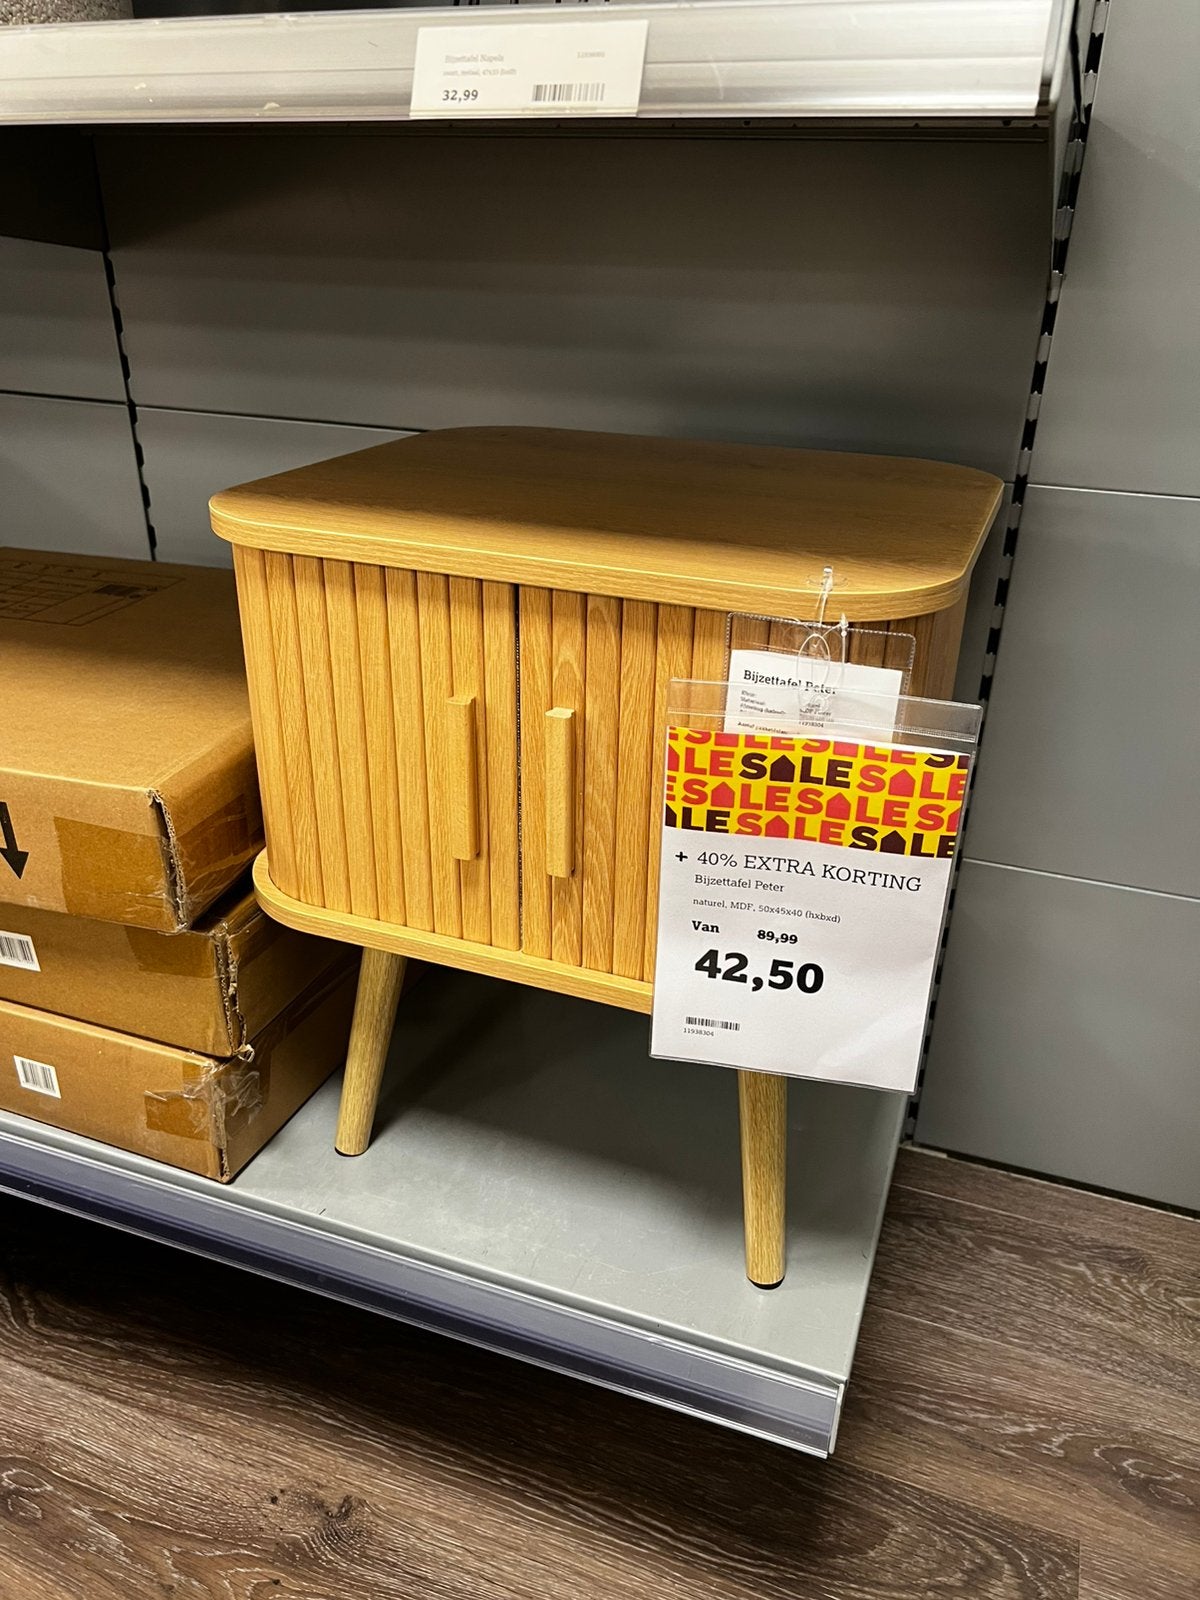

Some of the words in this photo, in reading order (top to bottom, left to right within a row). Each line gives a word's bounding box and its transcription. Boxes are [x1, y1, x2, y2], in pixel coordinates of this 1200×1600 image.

[442, 90, 479, 103] 32,99
[743, 669, 802, 687] Bijzettafel
[738, 752, 853, 789] SALE
[697, 851, 738, 868] 40%
[744, 855, 815, 876] EXTRA
[821, 864, 921, 891] KORTING
[694, 874, 751, 889] Bijzettafel
[755, 880, 785, 892] Peter
[758, 904, 803, 917] 50x45x40
[805, 910, 841, 923] (hxbxd)
[692, 920, 720, 933] Van
[757, 929, 798, 944] 89,99
[694, 949, 824, 994] 42,50
[683, 1027, 715, 1037] 11938304
